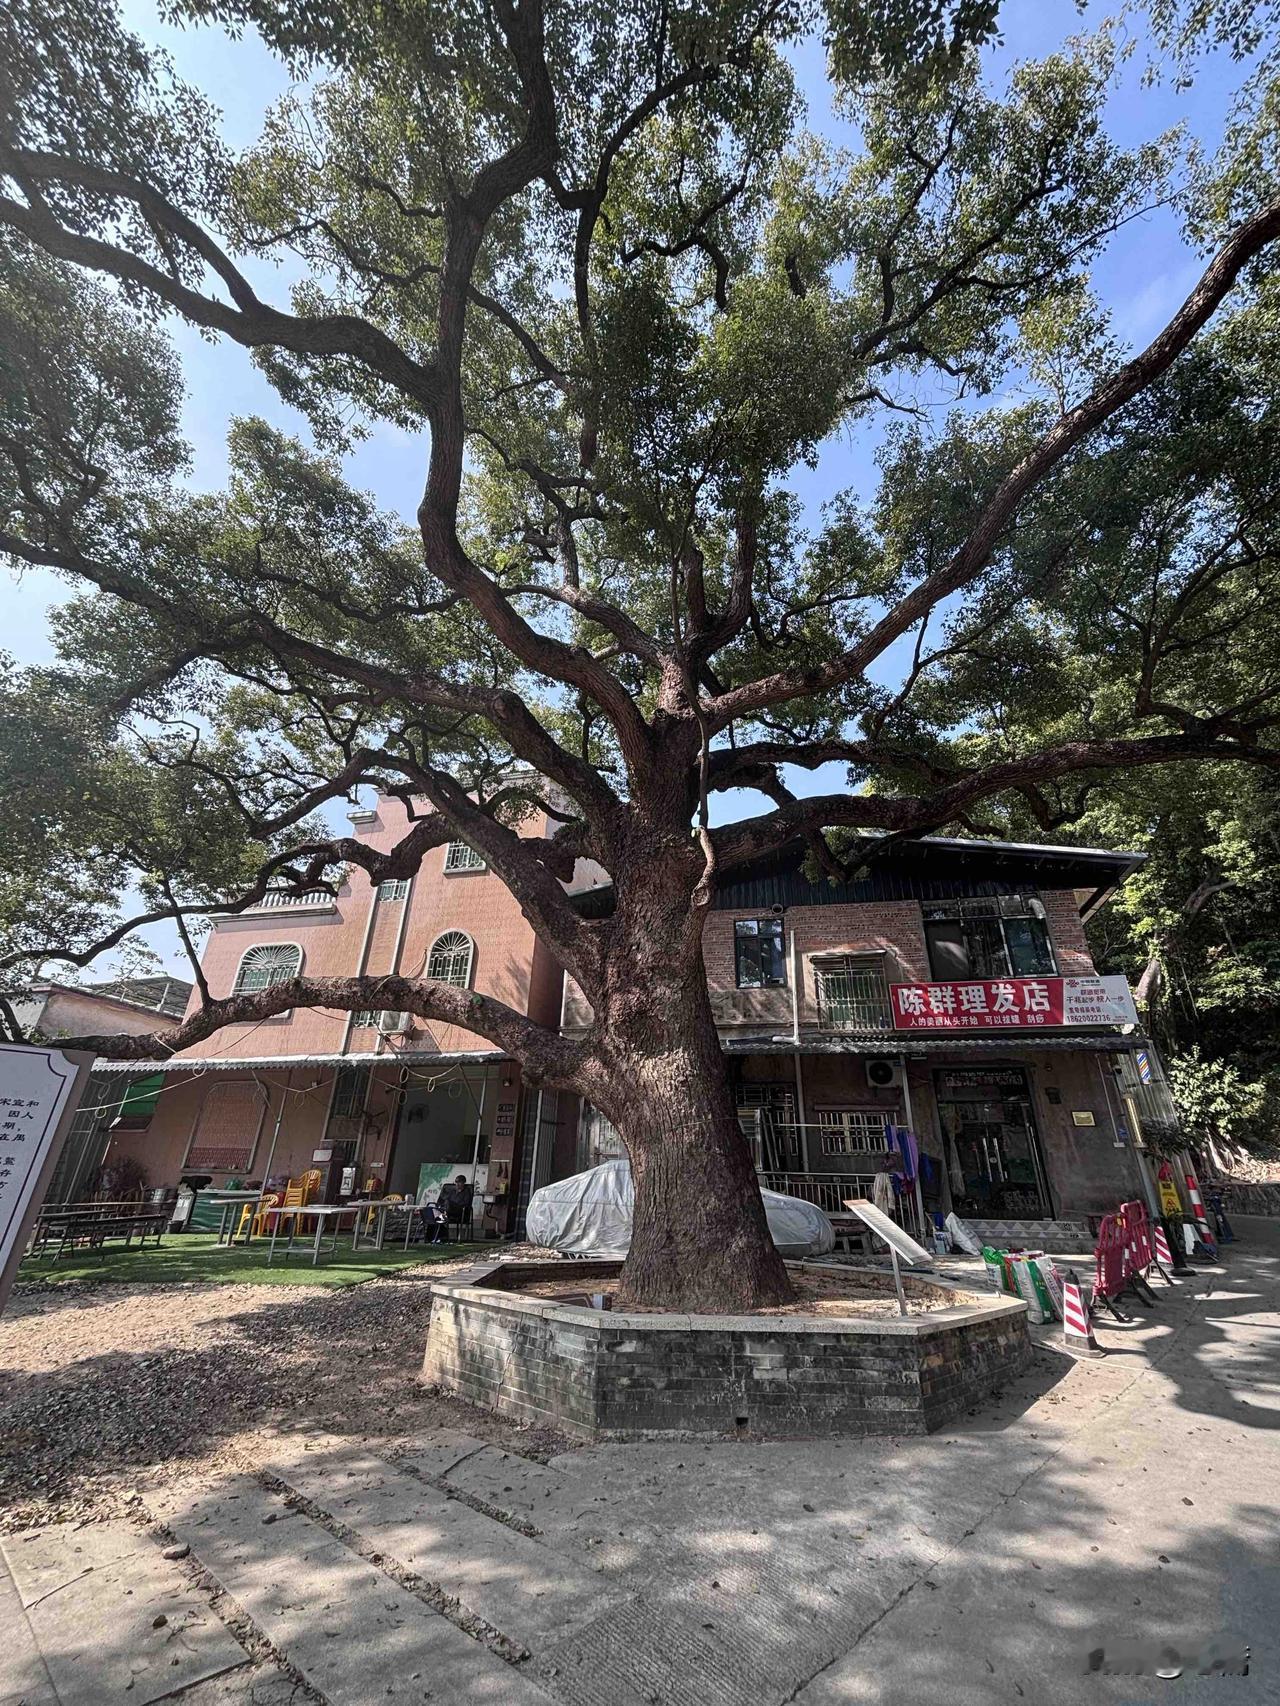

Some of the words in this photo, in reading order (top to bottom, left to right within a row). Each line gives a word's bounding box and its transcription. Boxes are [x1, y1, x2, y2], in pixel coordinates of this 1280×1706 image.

[897, 982, 1051, 1016] 陈群理发店
[910, 1015, 978, 1027] 人的美丽从头开始
[1066, 1014, 1111, 1023] 18620022736
[0, 1098, 39, 1107] 宋宣和
[8, 1110, 34, 1119] 因人
